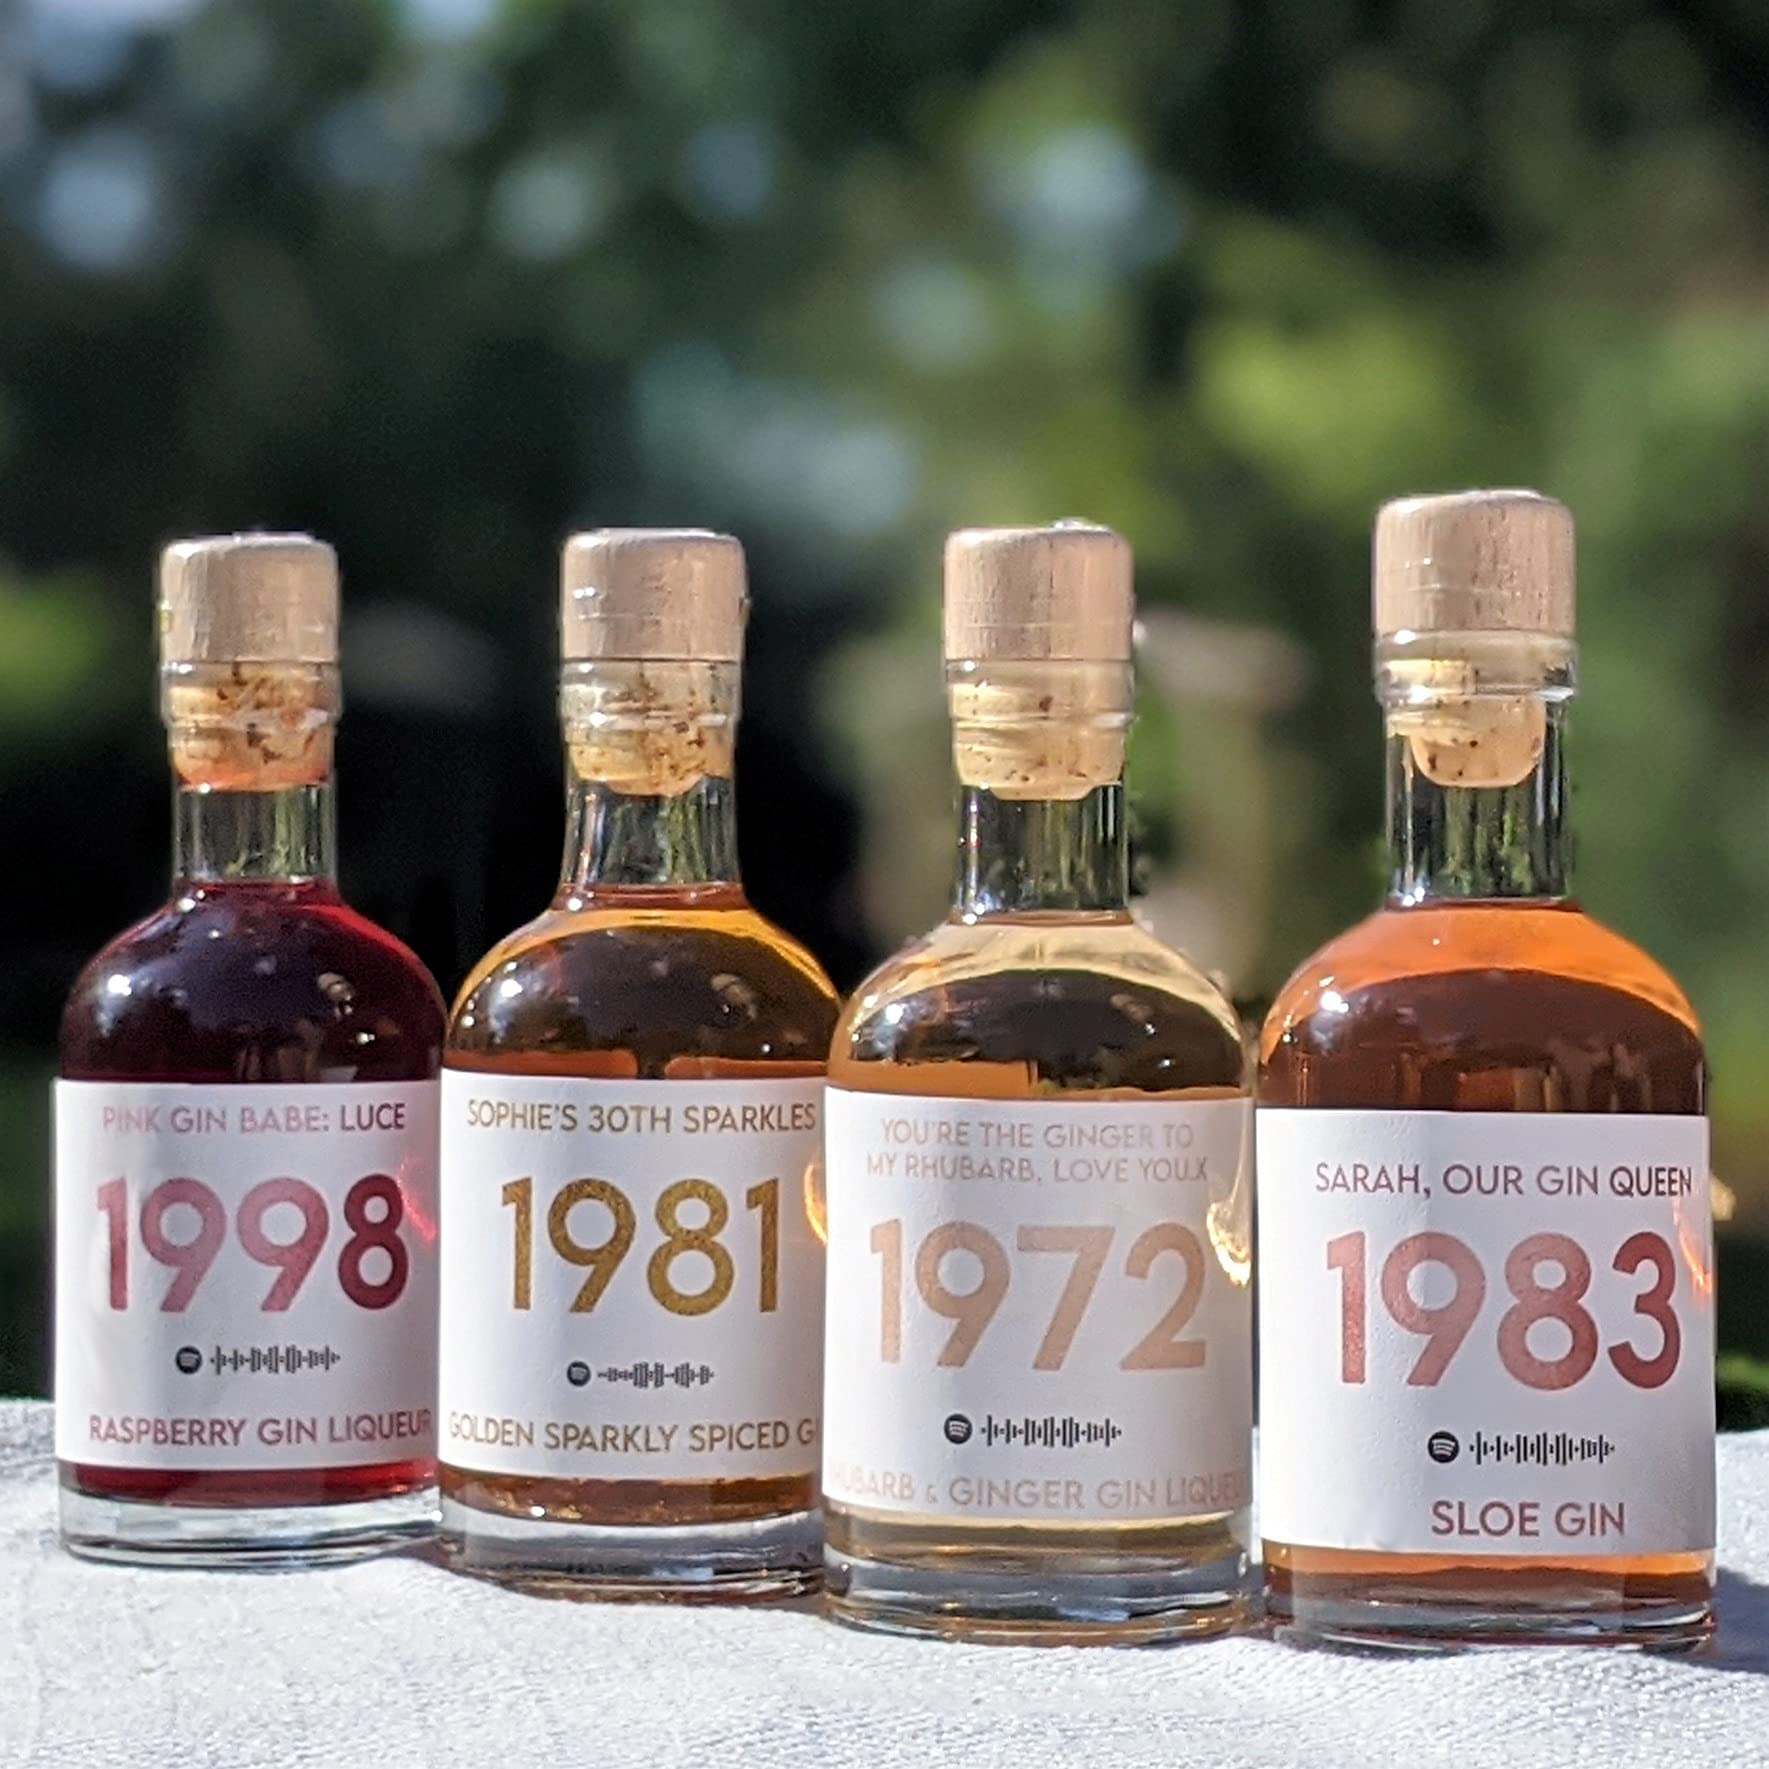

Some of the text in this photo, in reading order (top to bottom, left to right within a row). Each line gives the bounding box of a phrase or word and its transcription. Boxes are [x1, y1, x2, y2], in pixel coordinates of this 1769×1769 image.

[103, 1102, 406, 1134] PINK GIN BABE: LUCE
[467, 1098, 816, 1134] SOPHIE'S 30TH SPARKLES
[881, 1117, 1194, 1150] YOU'RE THE GINGER TO
[866, 1151, 898, 1178] MY
[1053, 1156, 1129, 1183] LOVE
[1316, 1162, 1693, 1198] SARAH, OUR GIN QUEEN
[96, 1173, 410, 1314] 1998
[501, 1176, 780, 1317] 1981
[870, 1218, 1207, 1373] 1972
[1327, 1230, 1682, 1391] 1983
[89, 1408, 432, 1447] RASPBERRY GIN LIQUEUR
[449, 1410, 535, 1447] GOLDEN
[544, 1421, 679, 1454] SPARKLY
[688, 1418, 790, 1453] SPICED
[948, 1476, 1087, 1510] GINGER
[1098, 1478, 1156, 1510] GIN
[1431, 1500, 1626, 1538] SLOE GIN
